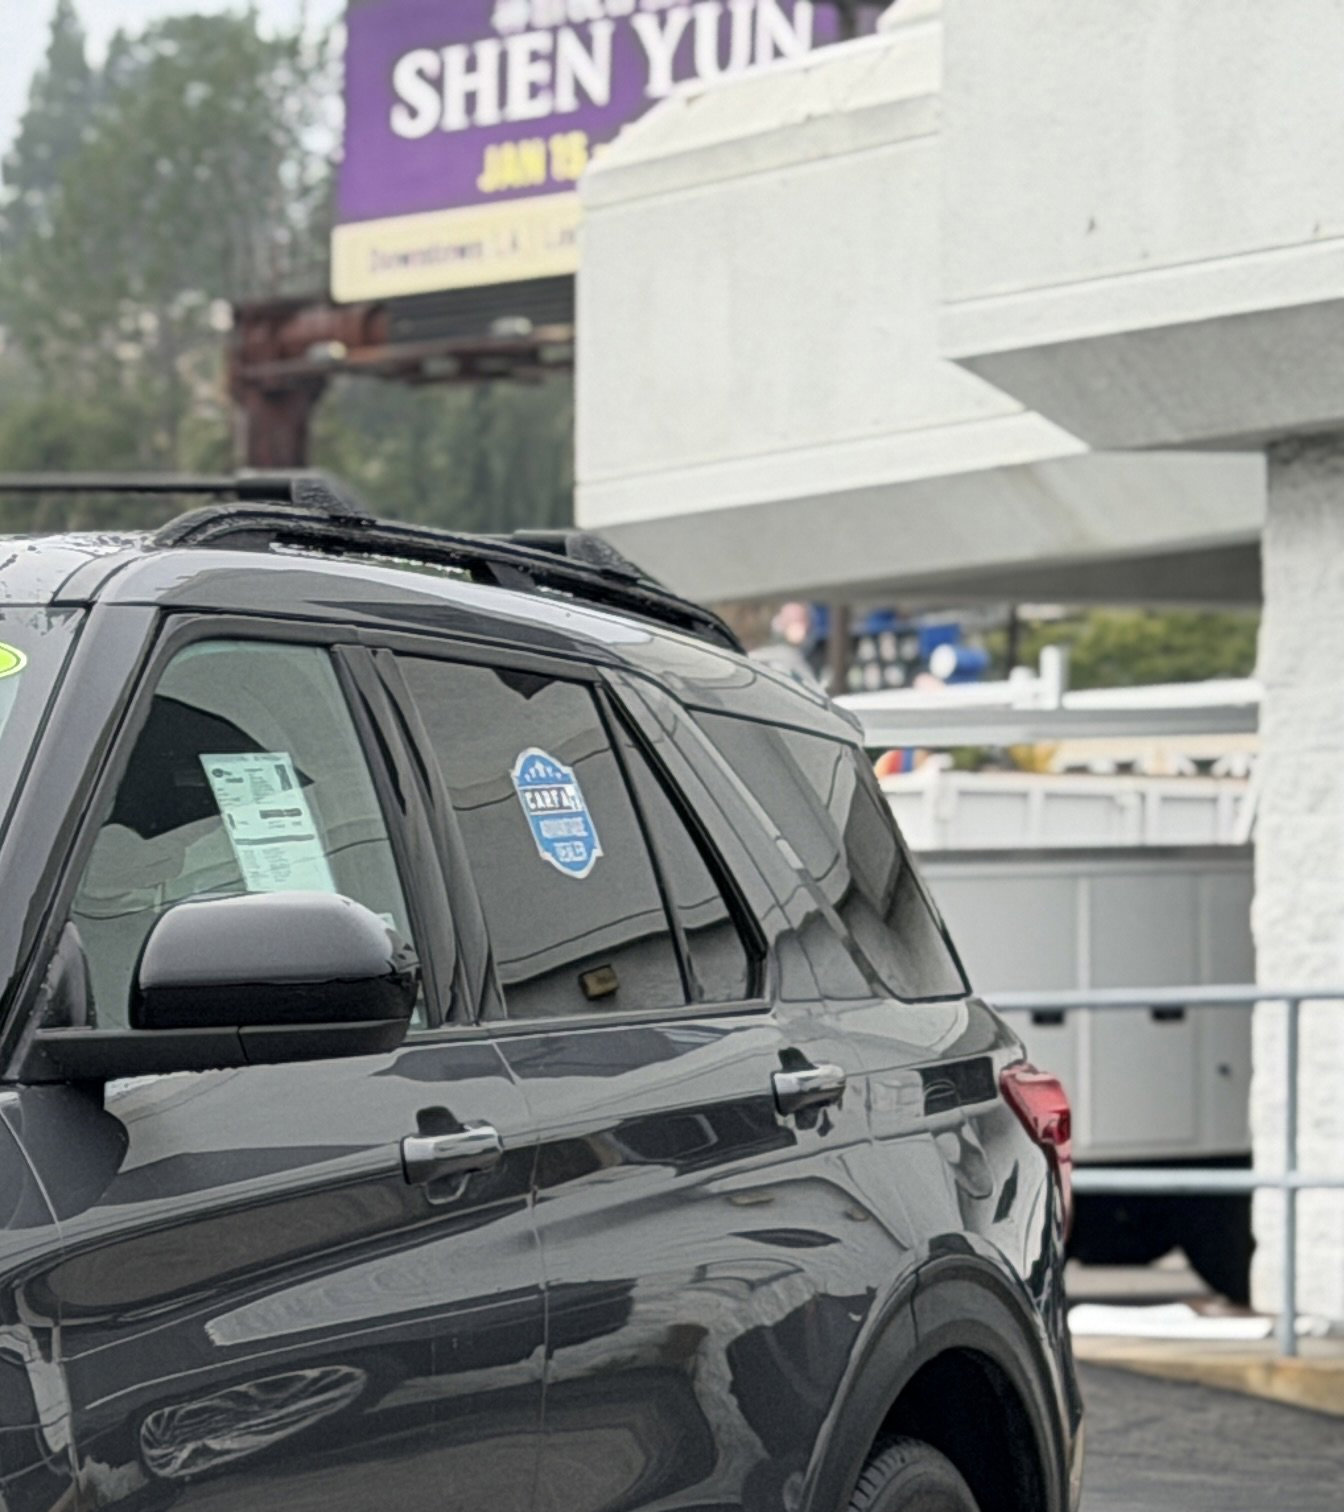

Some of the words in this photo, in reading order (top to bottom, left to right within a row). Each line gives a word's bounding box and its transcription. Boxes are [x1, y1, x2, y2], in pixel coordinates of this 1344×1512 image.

[391, 19, 615, 139] SHEN
[632, 0, 815, 98] YUN
[476, 136, 546, 193] JAN
